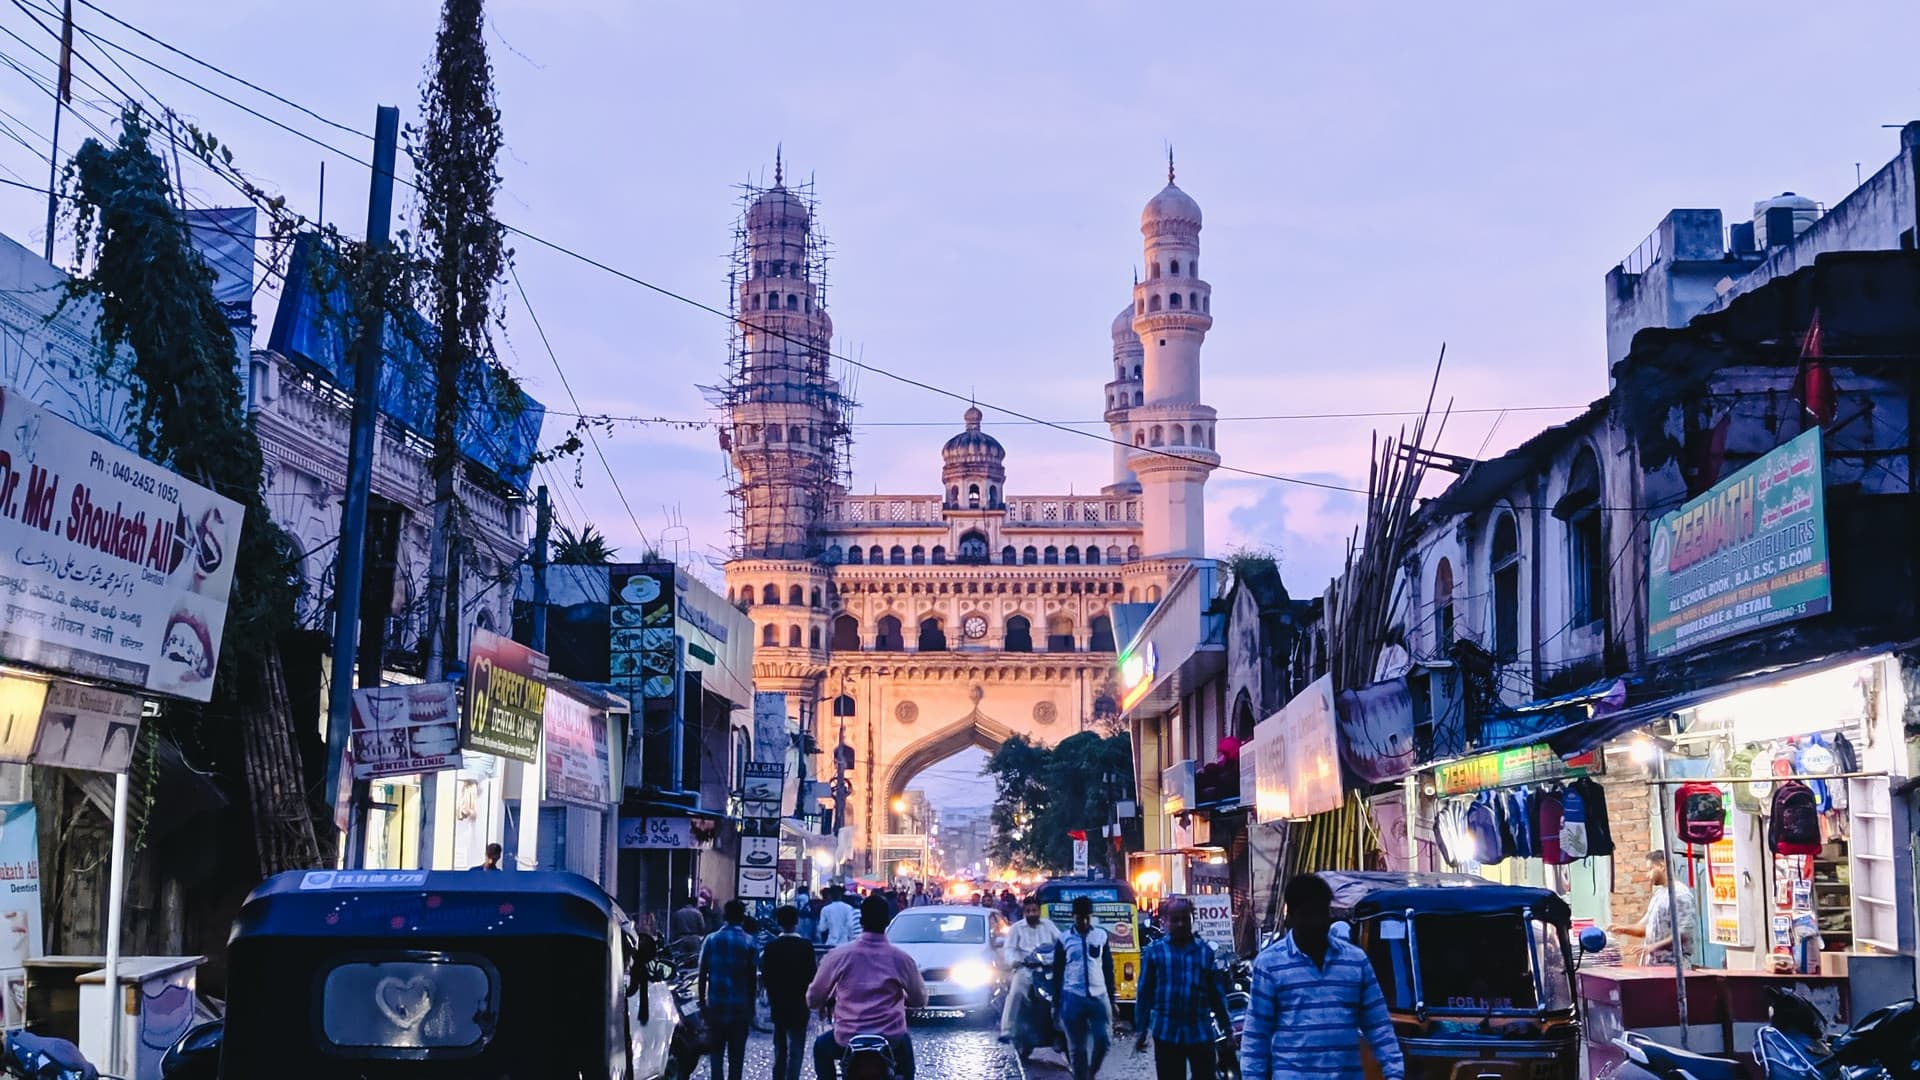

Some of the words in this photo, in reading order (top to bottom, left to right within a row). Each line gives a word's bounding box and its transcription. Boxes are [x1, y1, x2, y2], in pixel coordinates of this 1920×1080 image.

[90, 451, 104, 472] Ph
[112, 461, 155, 494] 040-2452
[157, 482, 179, 504] 1052
[66, 483, 148, 566] Shoukath
[1669, 474, 1755, 576] ZEENATH
[1730, 518, 1816, 572] DISTRIBUTORS
[1669, 597, 1681, 613] ALL
[1680, 586, 1708, 609] SCHOOL
[1779, 546, 1812, 571] B.COM
[1734, 595, 1774, 618] RETAIL
[490, 665, 525, 707] PERFECT
[523, 679, 546, 715] SMILE
[491, 706, 516, 737] DENTAL
[516, 714, 538, 743] CLINIC
[372, 760, 410, 772] DENTAL
[411, 756, 446, 768] CLINIC
[1442, 756, 1499, 795] ZEENATH
[10, 883, 38, 893] Dentist
[1447, 996, 1476, 1008] FOR
[1479, 997, 1513, 1009] HRE
